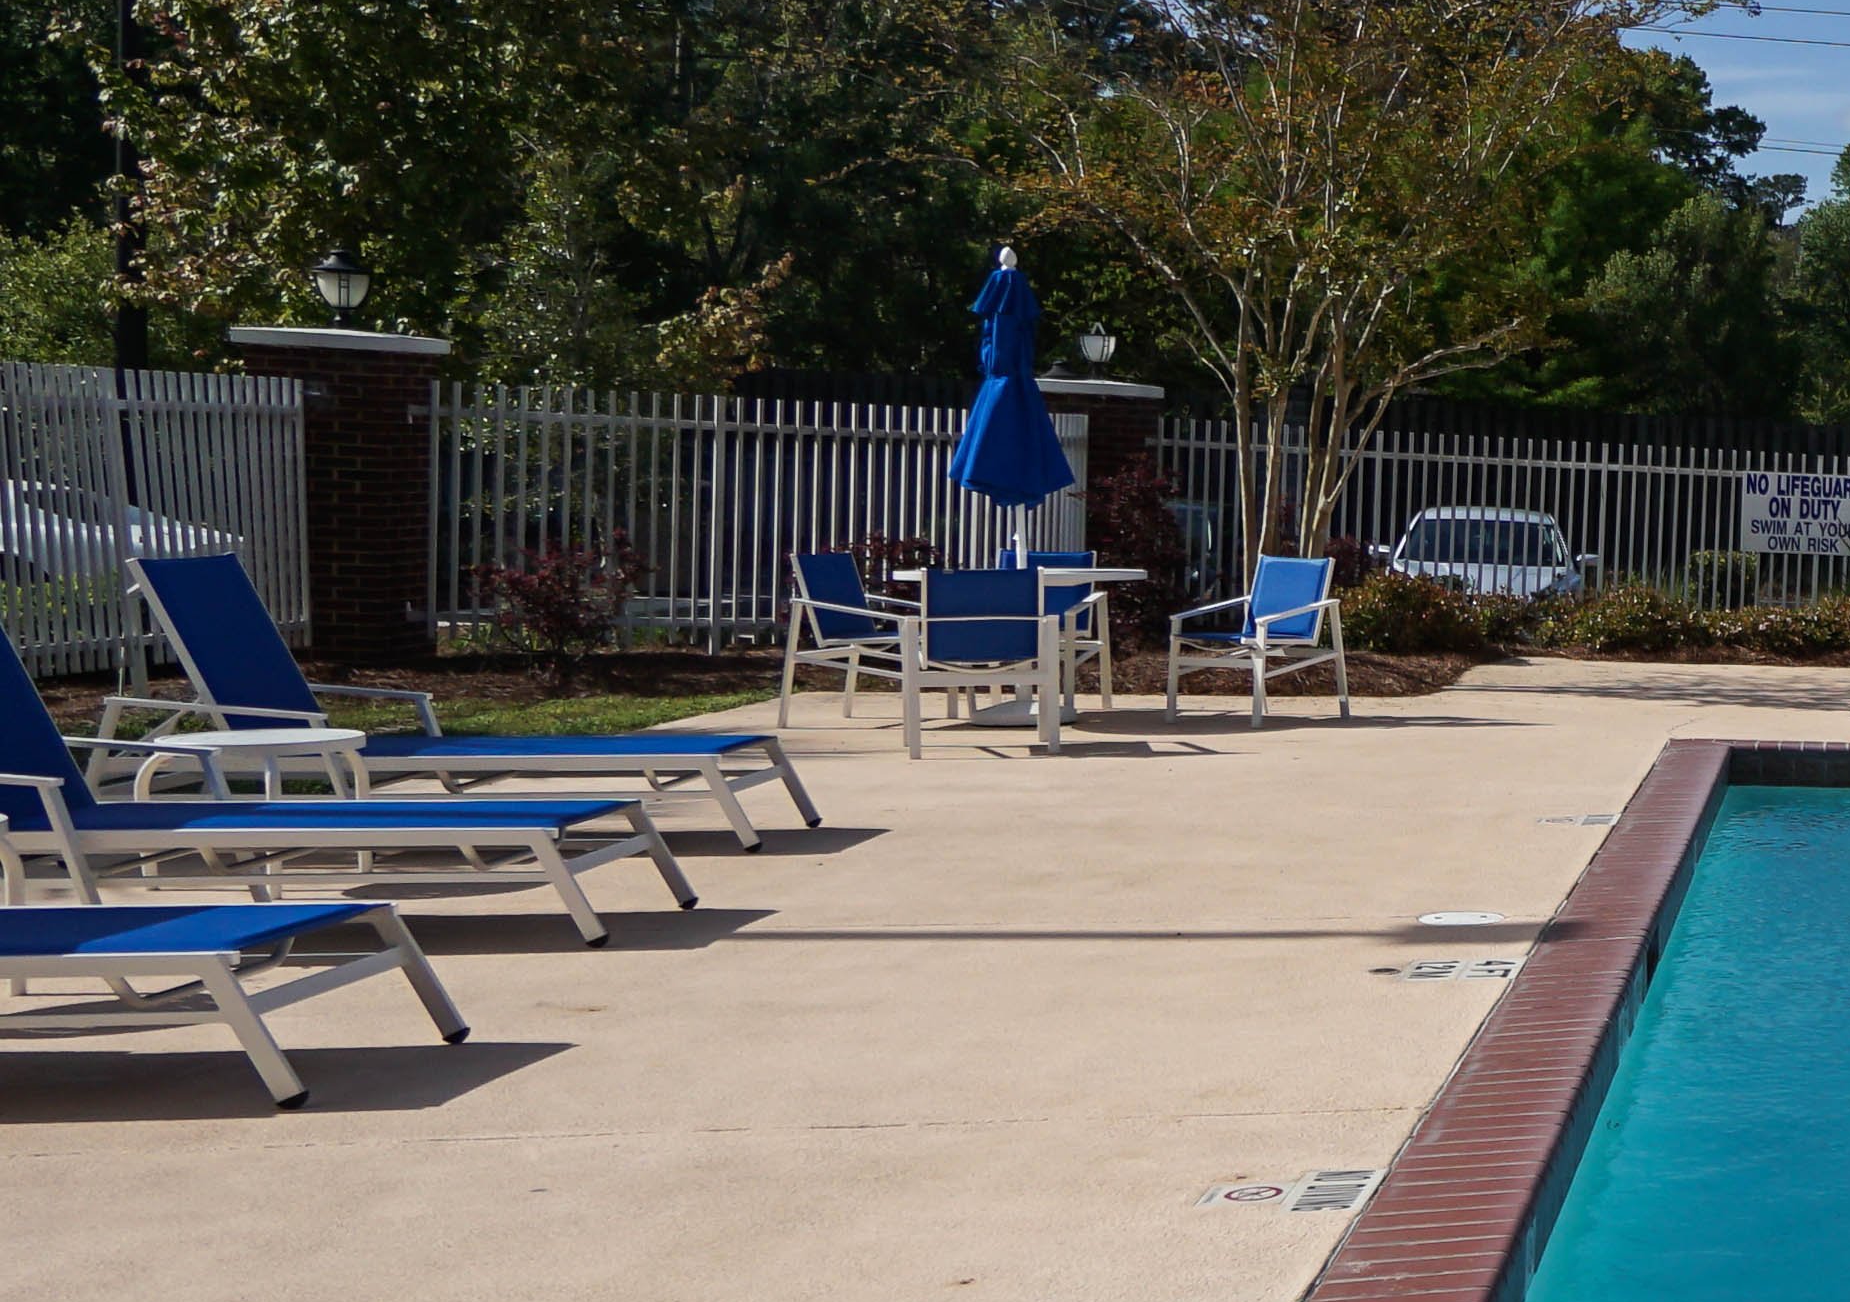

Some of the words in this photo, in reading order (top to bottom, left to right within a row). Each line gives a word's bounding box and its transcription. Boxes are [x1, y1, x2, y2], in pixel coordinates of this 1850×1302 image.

[1746, 474, 1769, 495] NO
[1769, 497, 1791, 519] ON
[1800, 499, 1841, 520] DUTY
[1751, 520, 1787, 535] SWIM
[1794, 521, 1812, 536] AT
[1768, 536, 1800, 551] OWN
[1807, 538, 1839, 553] RISK
